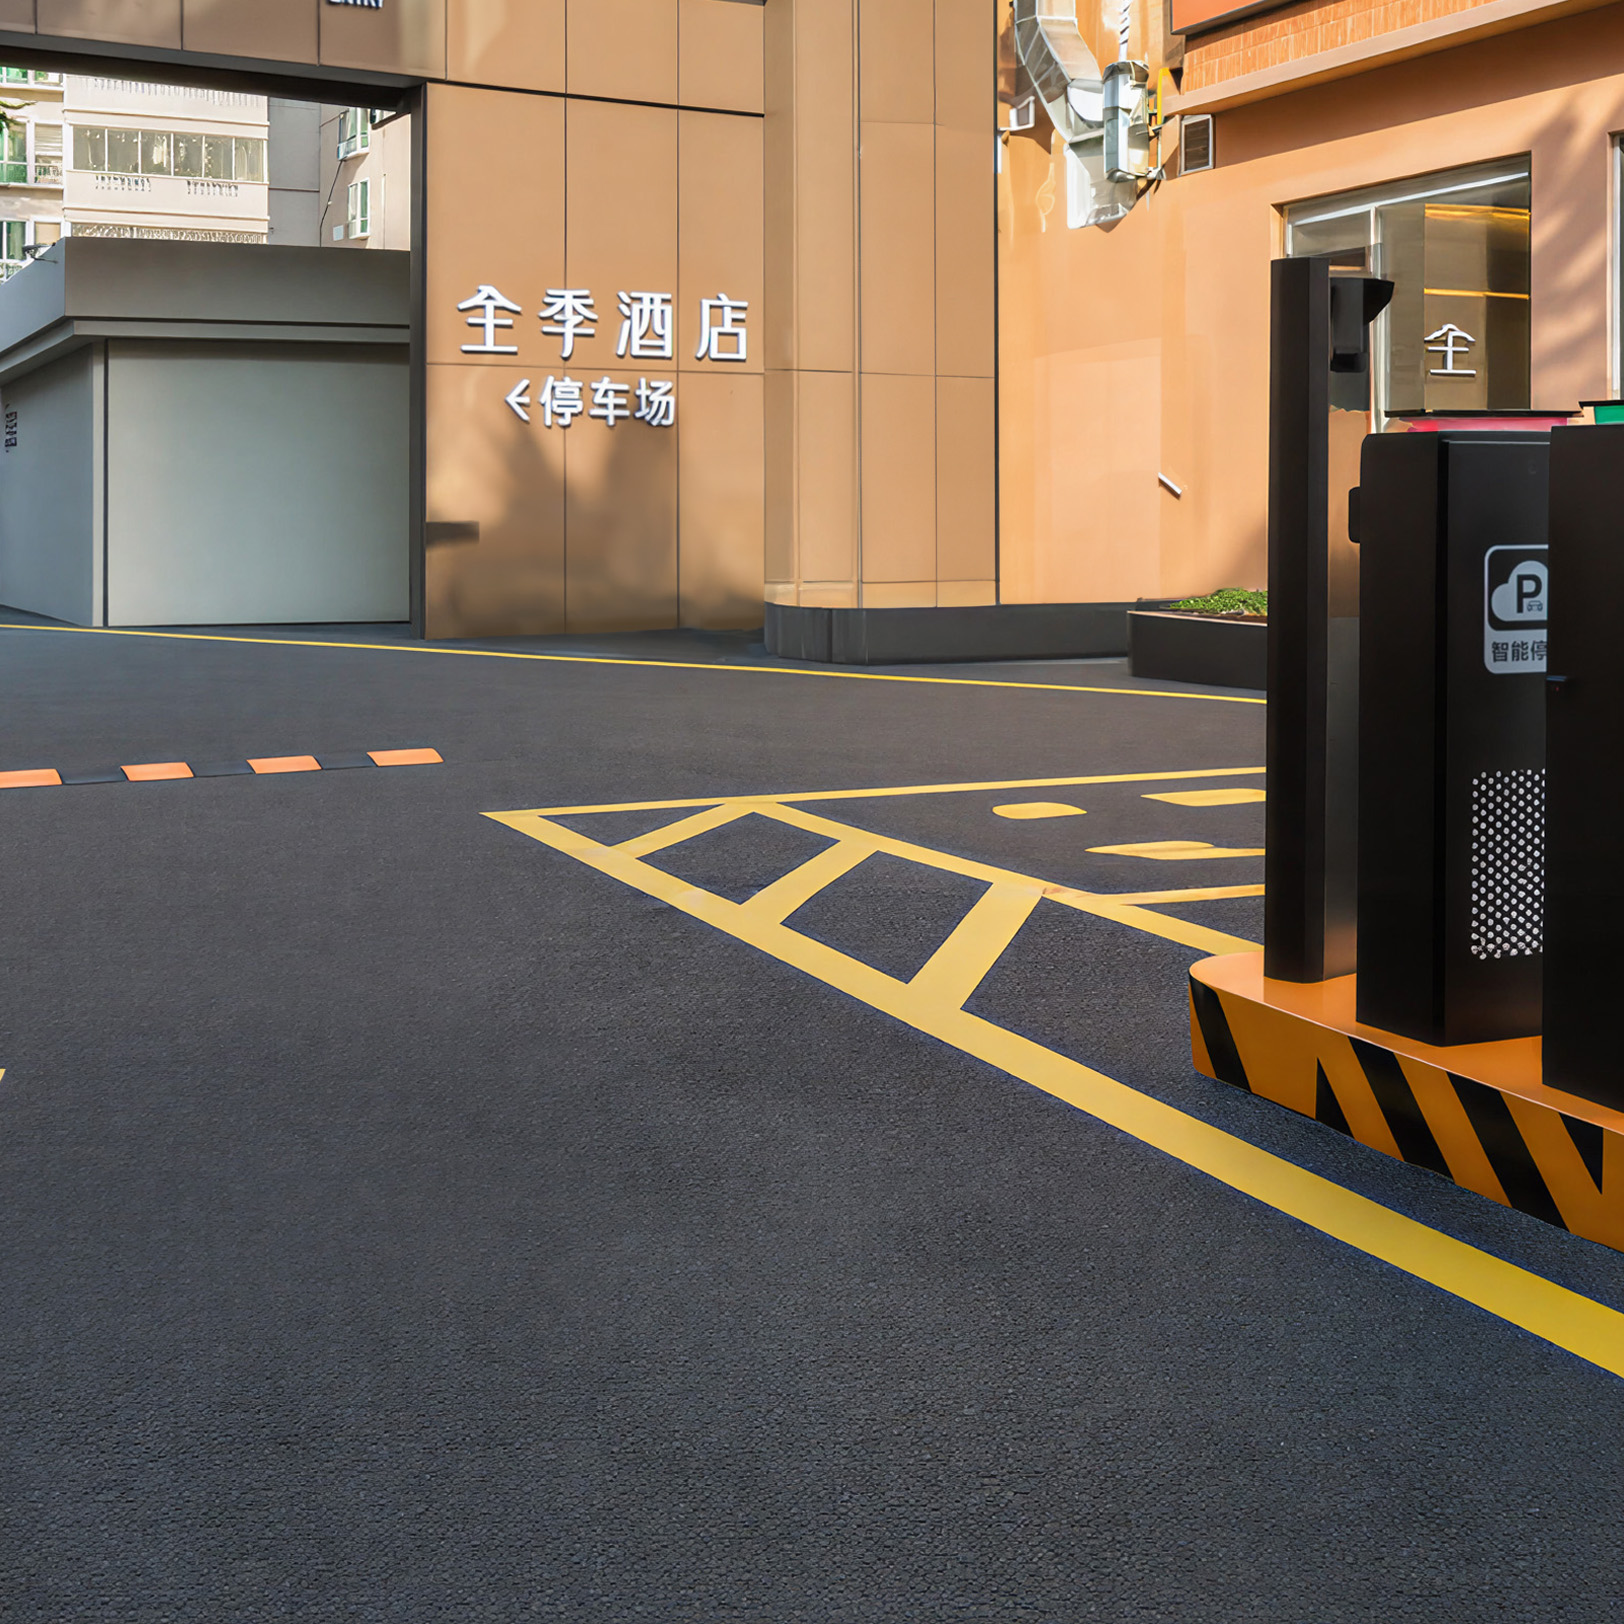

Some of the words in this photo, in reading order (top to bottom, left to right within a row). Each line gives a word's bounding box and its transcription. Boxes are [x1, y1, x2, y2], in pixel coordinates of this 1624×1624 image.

[457, 285, 749, 361] 全季酒店
[539, 376, 675, 427] 停车场
[1491, 640, 1547, 663] 智能停
